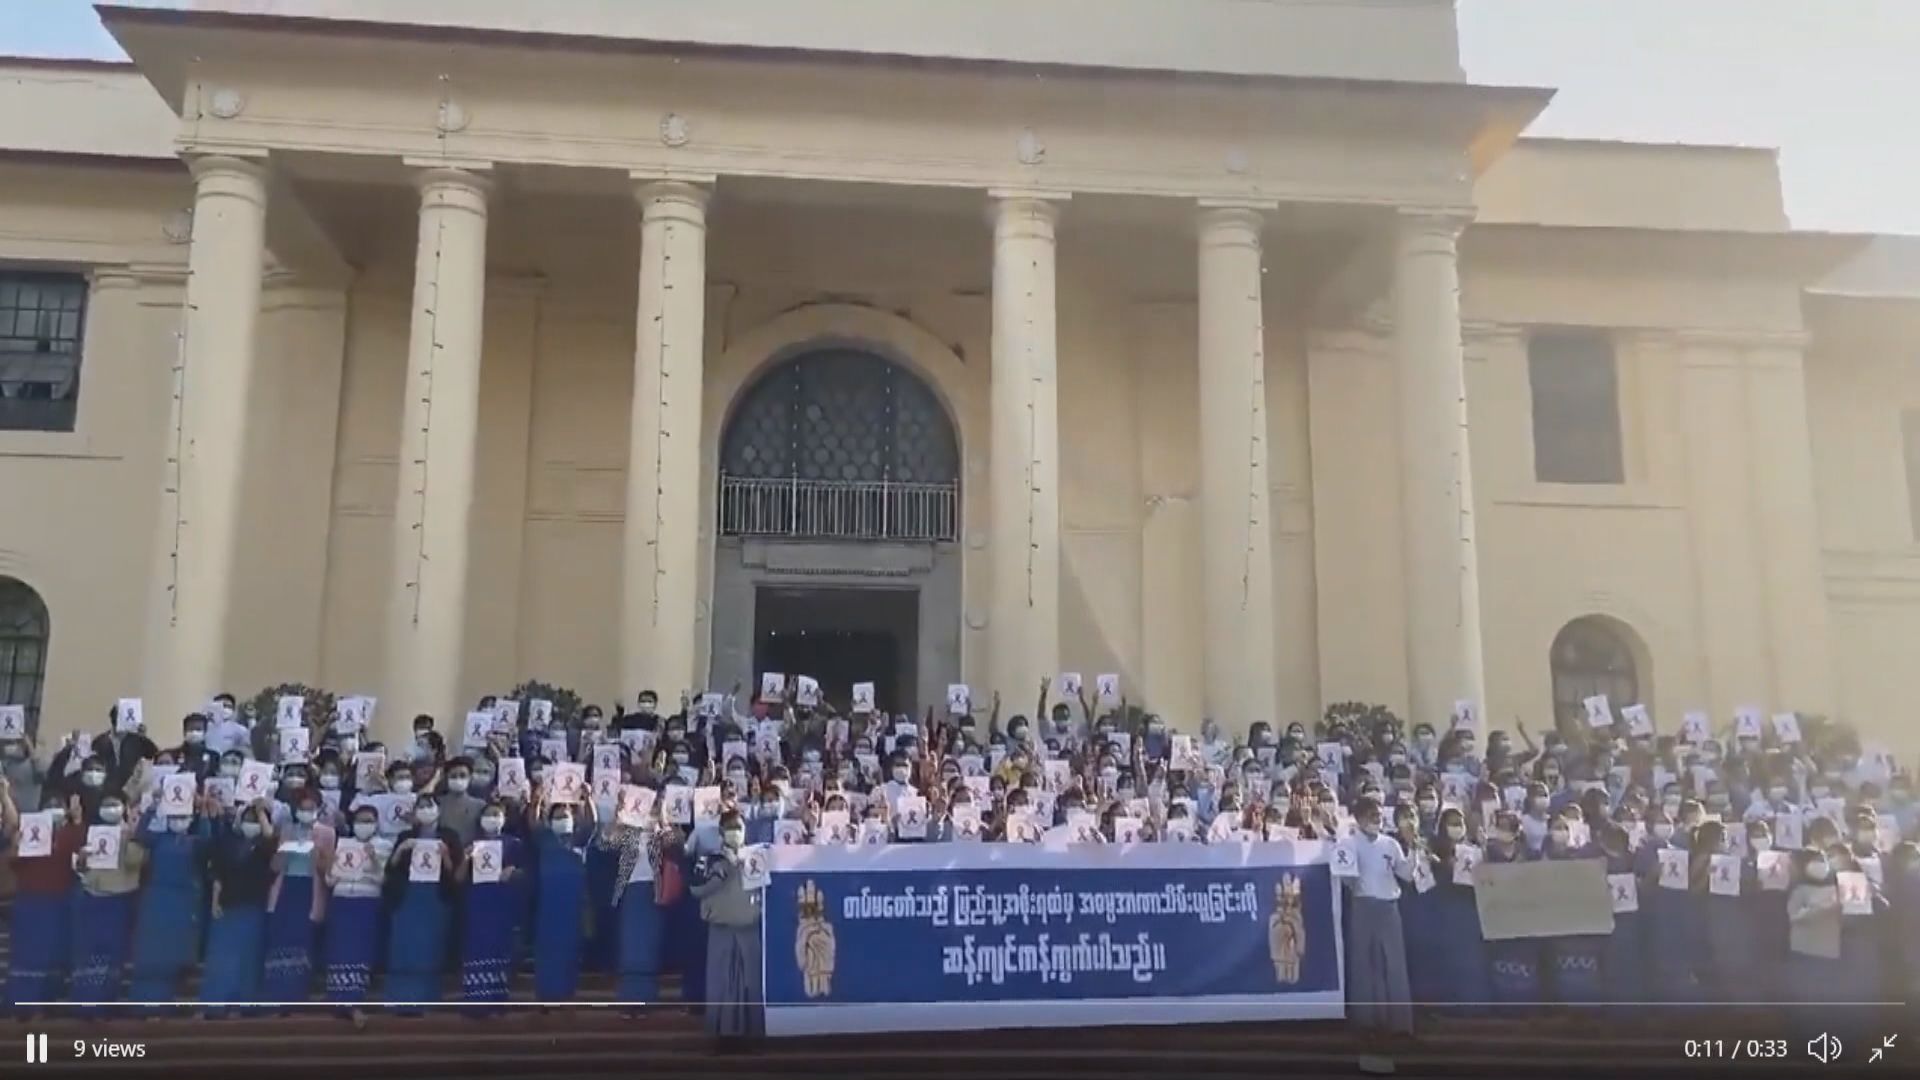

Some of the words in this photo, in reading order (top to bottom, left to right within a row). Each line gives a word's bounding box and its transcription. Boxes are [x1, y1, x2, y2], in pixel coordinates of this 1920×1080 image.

[843, 886, 949, 926] တပ်မတော်သည်
